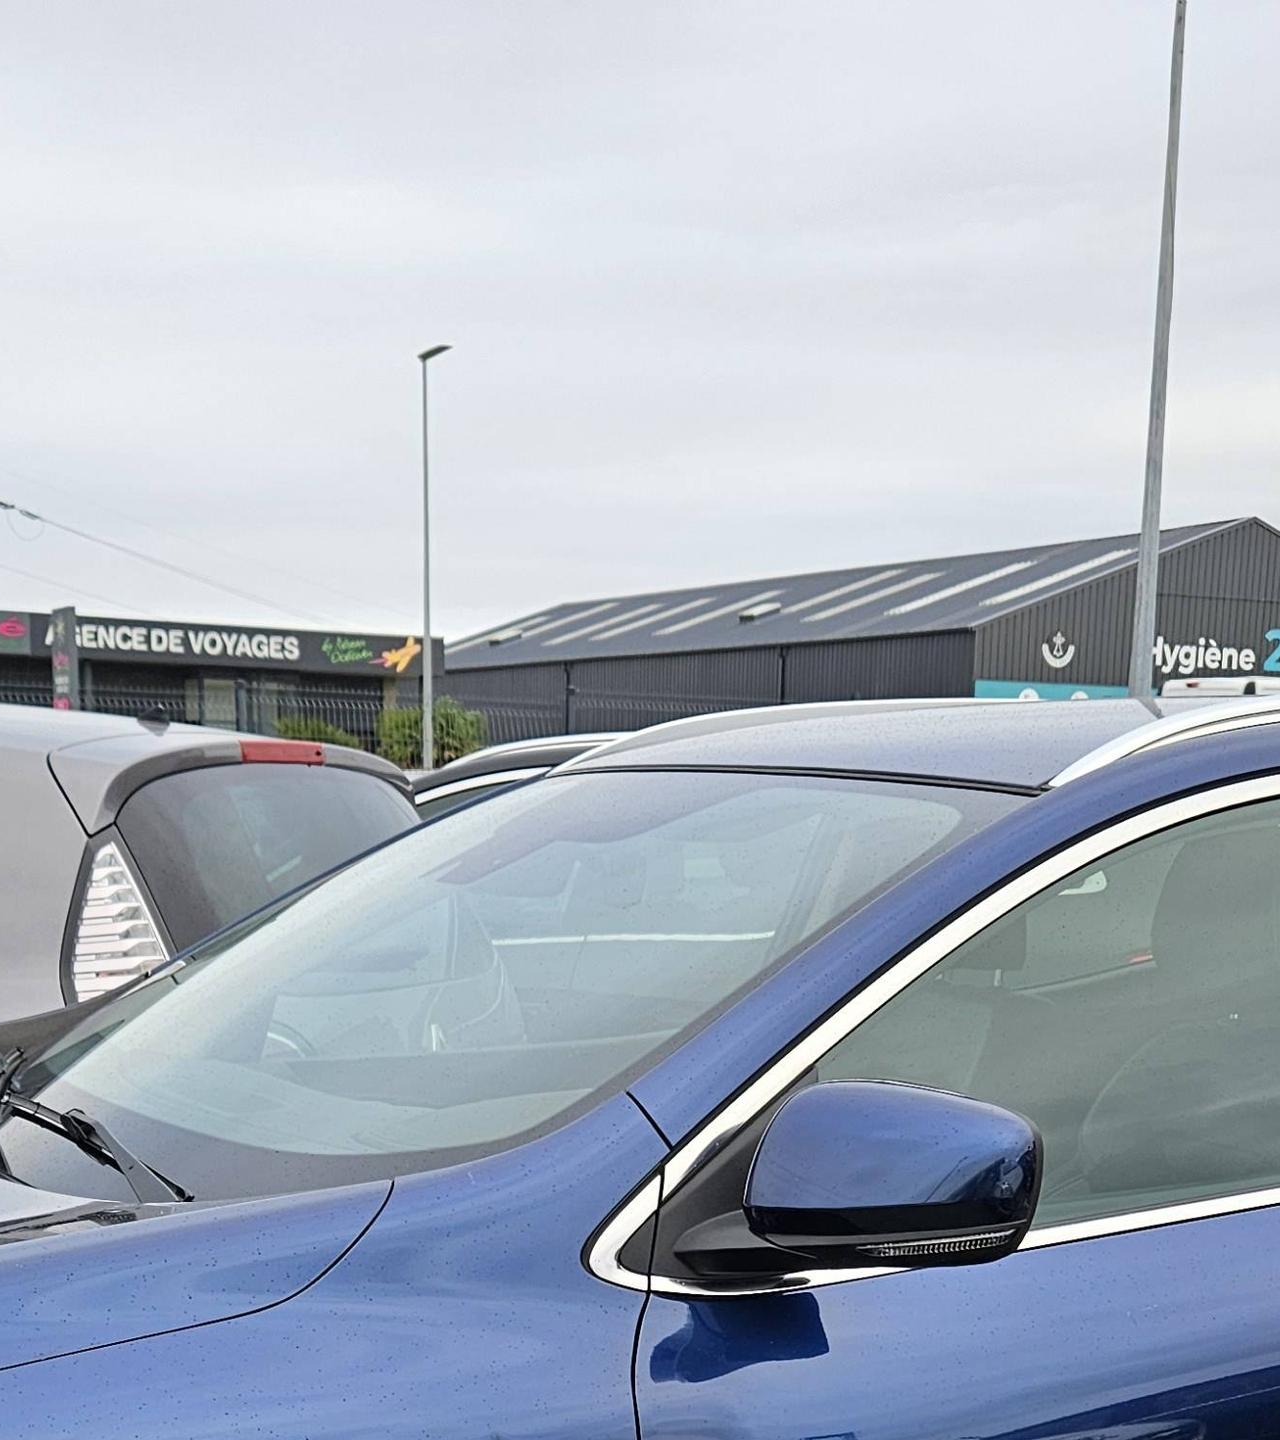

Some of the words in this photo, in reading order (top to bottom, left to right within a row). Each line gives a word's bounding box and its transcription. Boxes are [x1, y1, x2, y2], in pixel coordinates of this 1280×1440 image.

[150, 627, 185, 654] DE
[186, 630, 300, 662] VOYAGES
[1152, 635, 1256, 675] Hygiène
